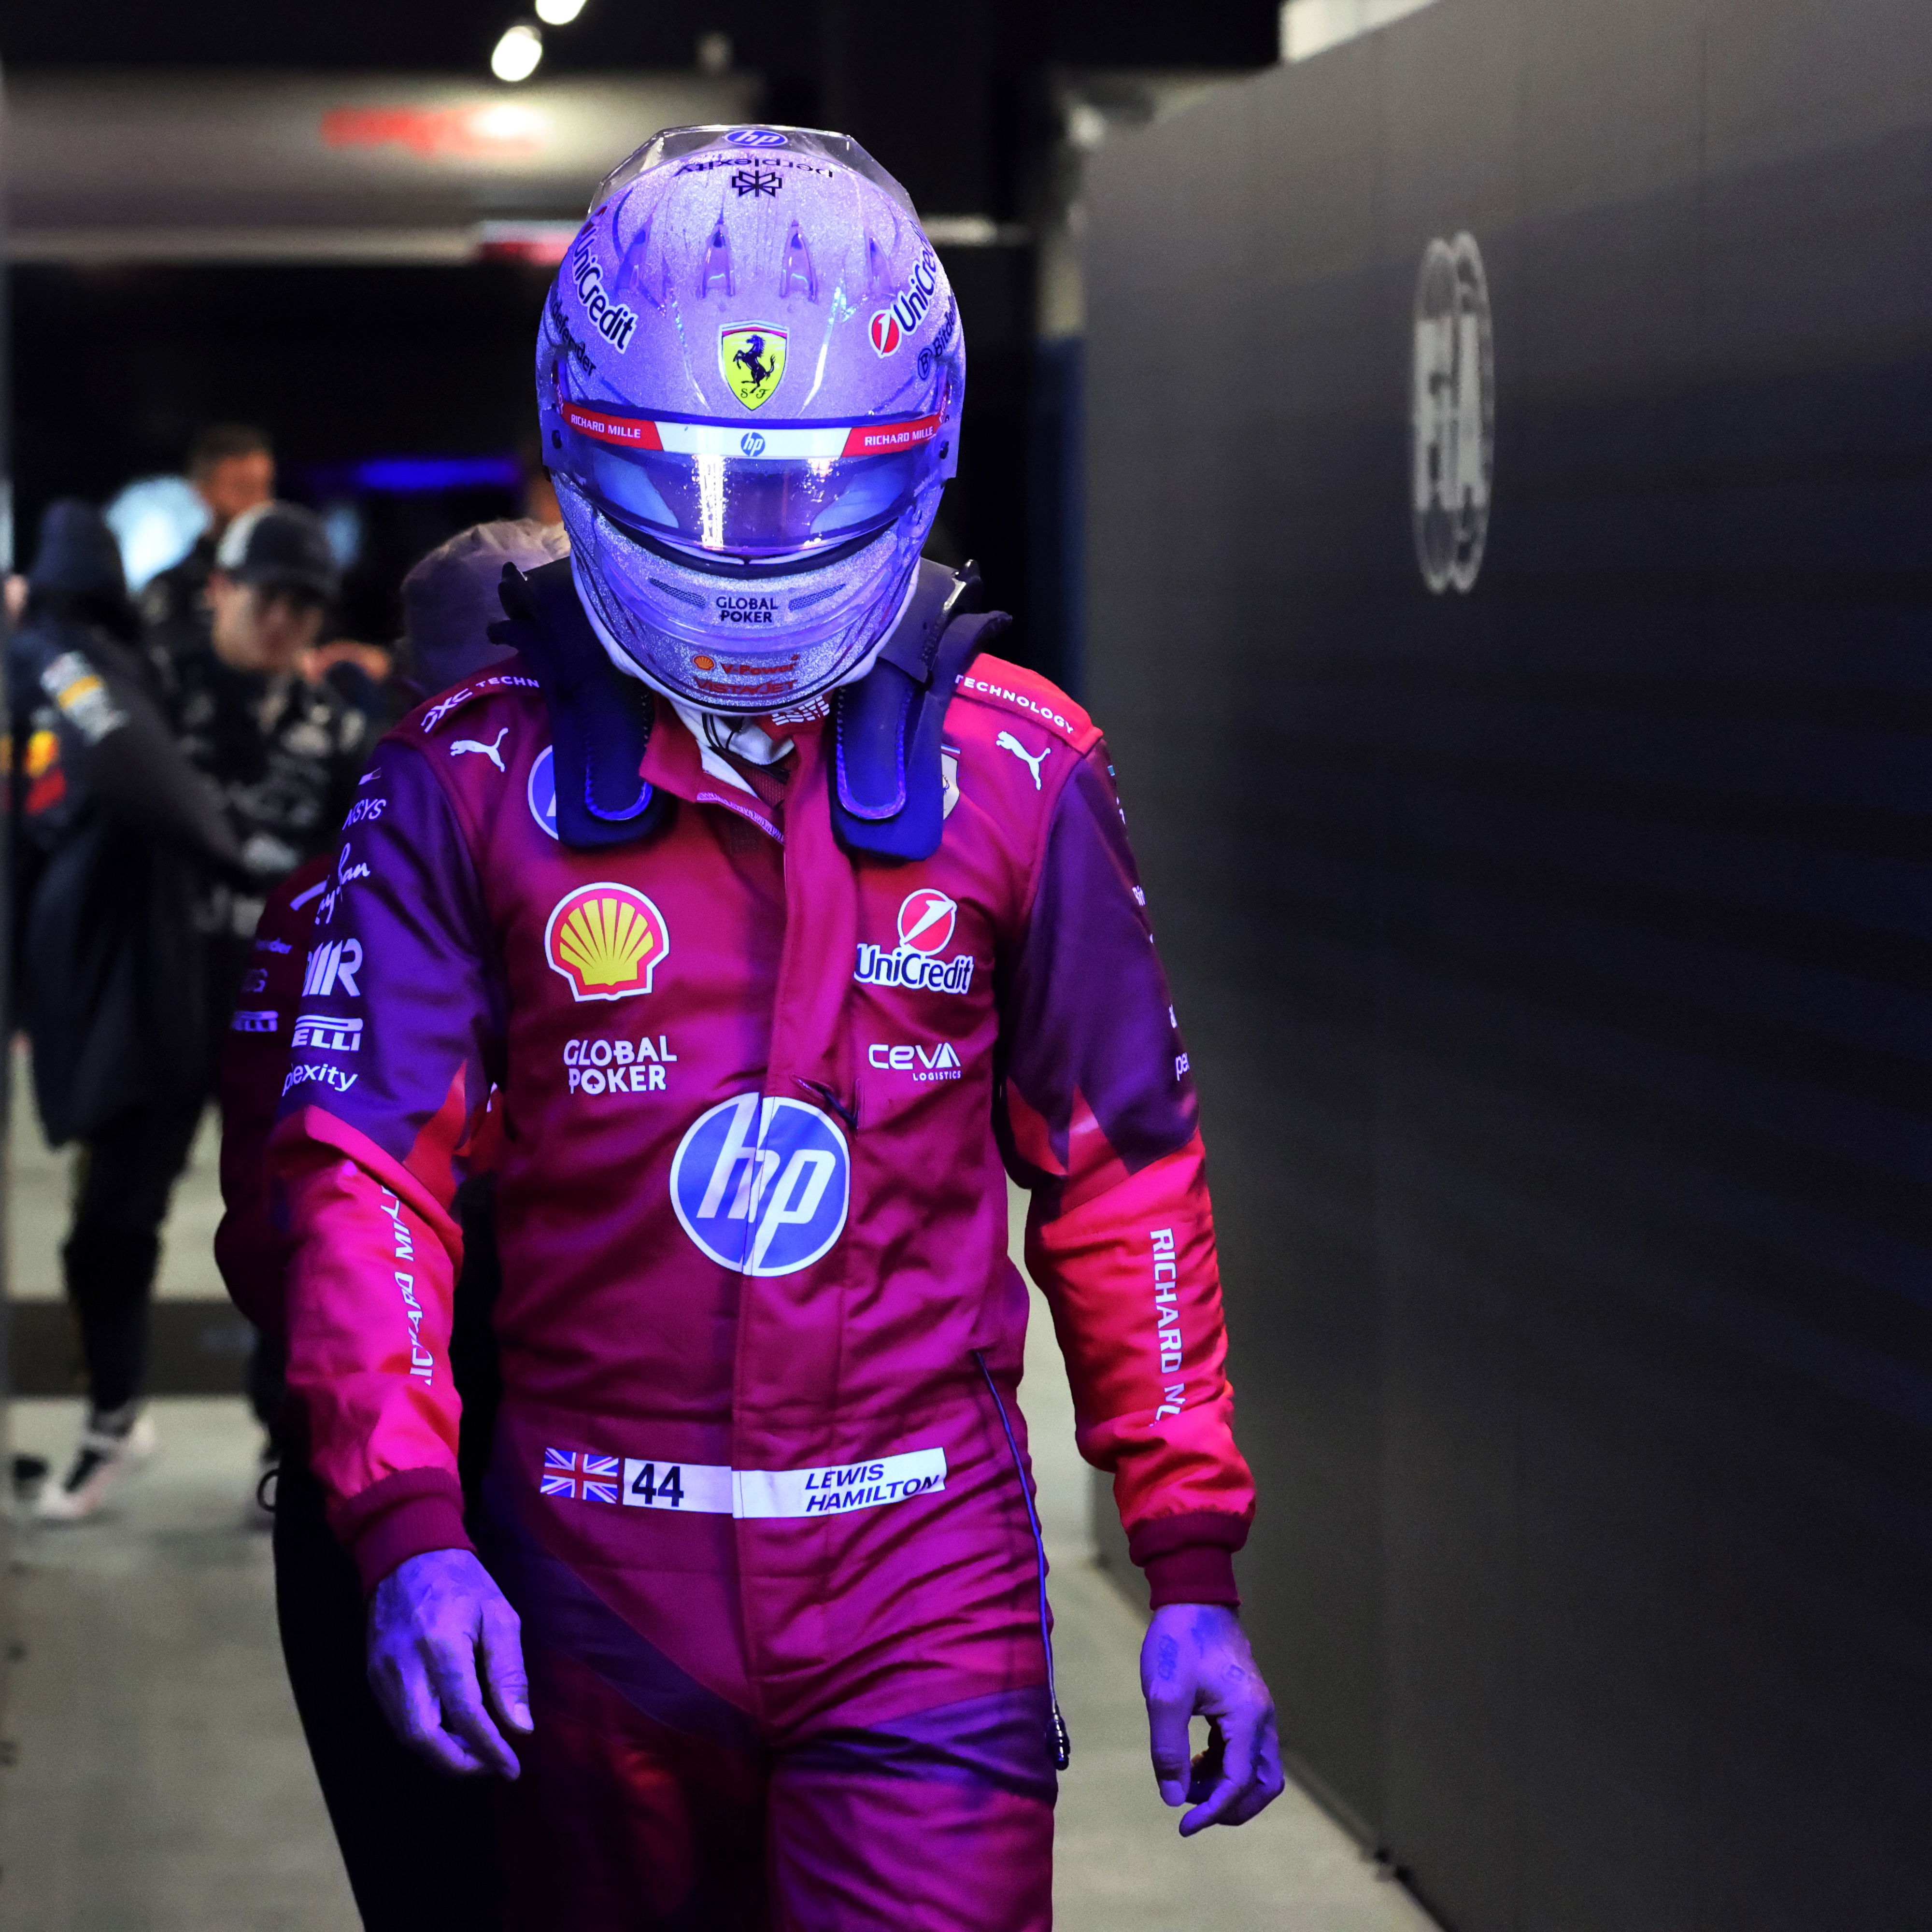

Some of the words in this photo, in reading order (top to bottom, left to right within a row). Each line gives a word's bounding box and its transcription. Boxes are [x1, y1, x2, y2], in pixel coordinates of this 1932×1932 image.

[733, 130, 781, 146] hp
[573, 227, 634, 351] UniCredit
[571, 414, 605, 433] RICHARD
[608, 425, 641, 439] MILLE
[865, 432, 910, 446] RICHARD
[912, 426, 934, 440] MILLE
[743, 432, 764, 457] hp
[716, 597, 778, 610] GLOBAL
[720, 610, 772, 623] POKER
[721, 662, 797, 675] V-Power
[421, 688, 473, 733] DXC
[475, 676, 540, 688] TECHN
[954, 674, 1074, 734] TECHNOLOGY
[855, 948, 971, 990] UniCredit
[564, 1035, 678, 1066] GLOBAL
[568, 1065, 667, 1095] POKER
[913, 1071, 961, 1081] LOGISTICS
[696, 1094, 836, 1273] hp
[1150, 1228, 1183, 1374] RICHARD
[632, 1463, 684, 1507] 44
[805, 1463, 884, 1491] LEWIS
[806, 1475, 940, 1512] HAMILTON
